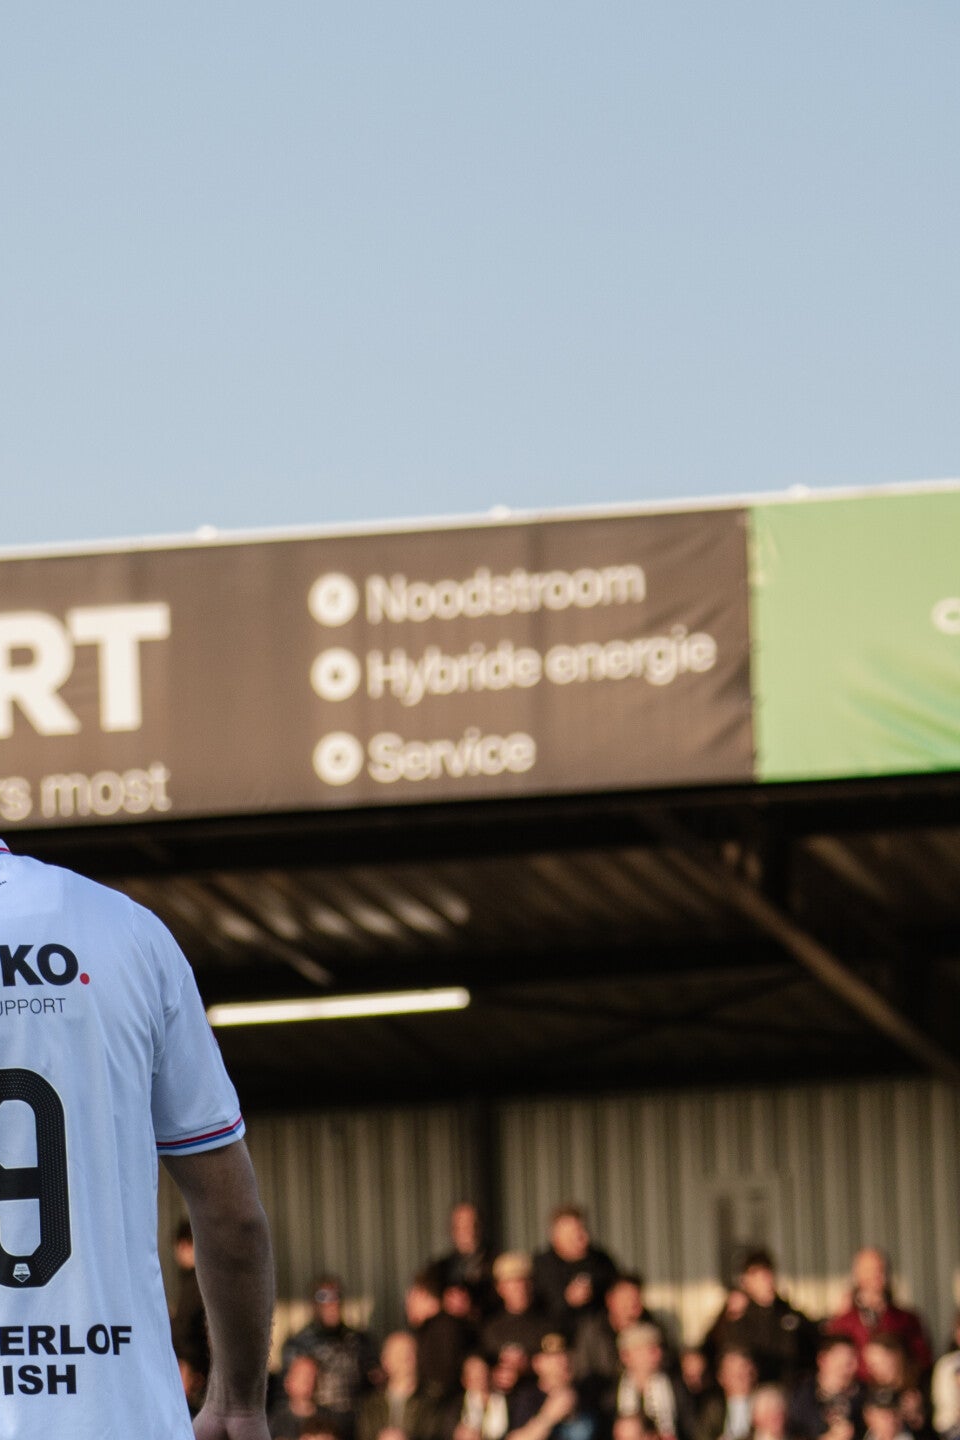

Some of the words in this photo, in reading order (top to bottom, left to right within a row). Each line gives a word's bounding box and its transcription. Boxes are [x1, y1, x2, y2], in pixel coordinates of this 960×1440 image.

[367, 565, 645, 623] Noodstroom
[367, 641, 541, 705] Hybride
[546, 625, 716, 685] energie
[368, 727, 536, 783] Service
[41, 762, 172, 817] most
